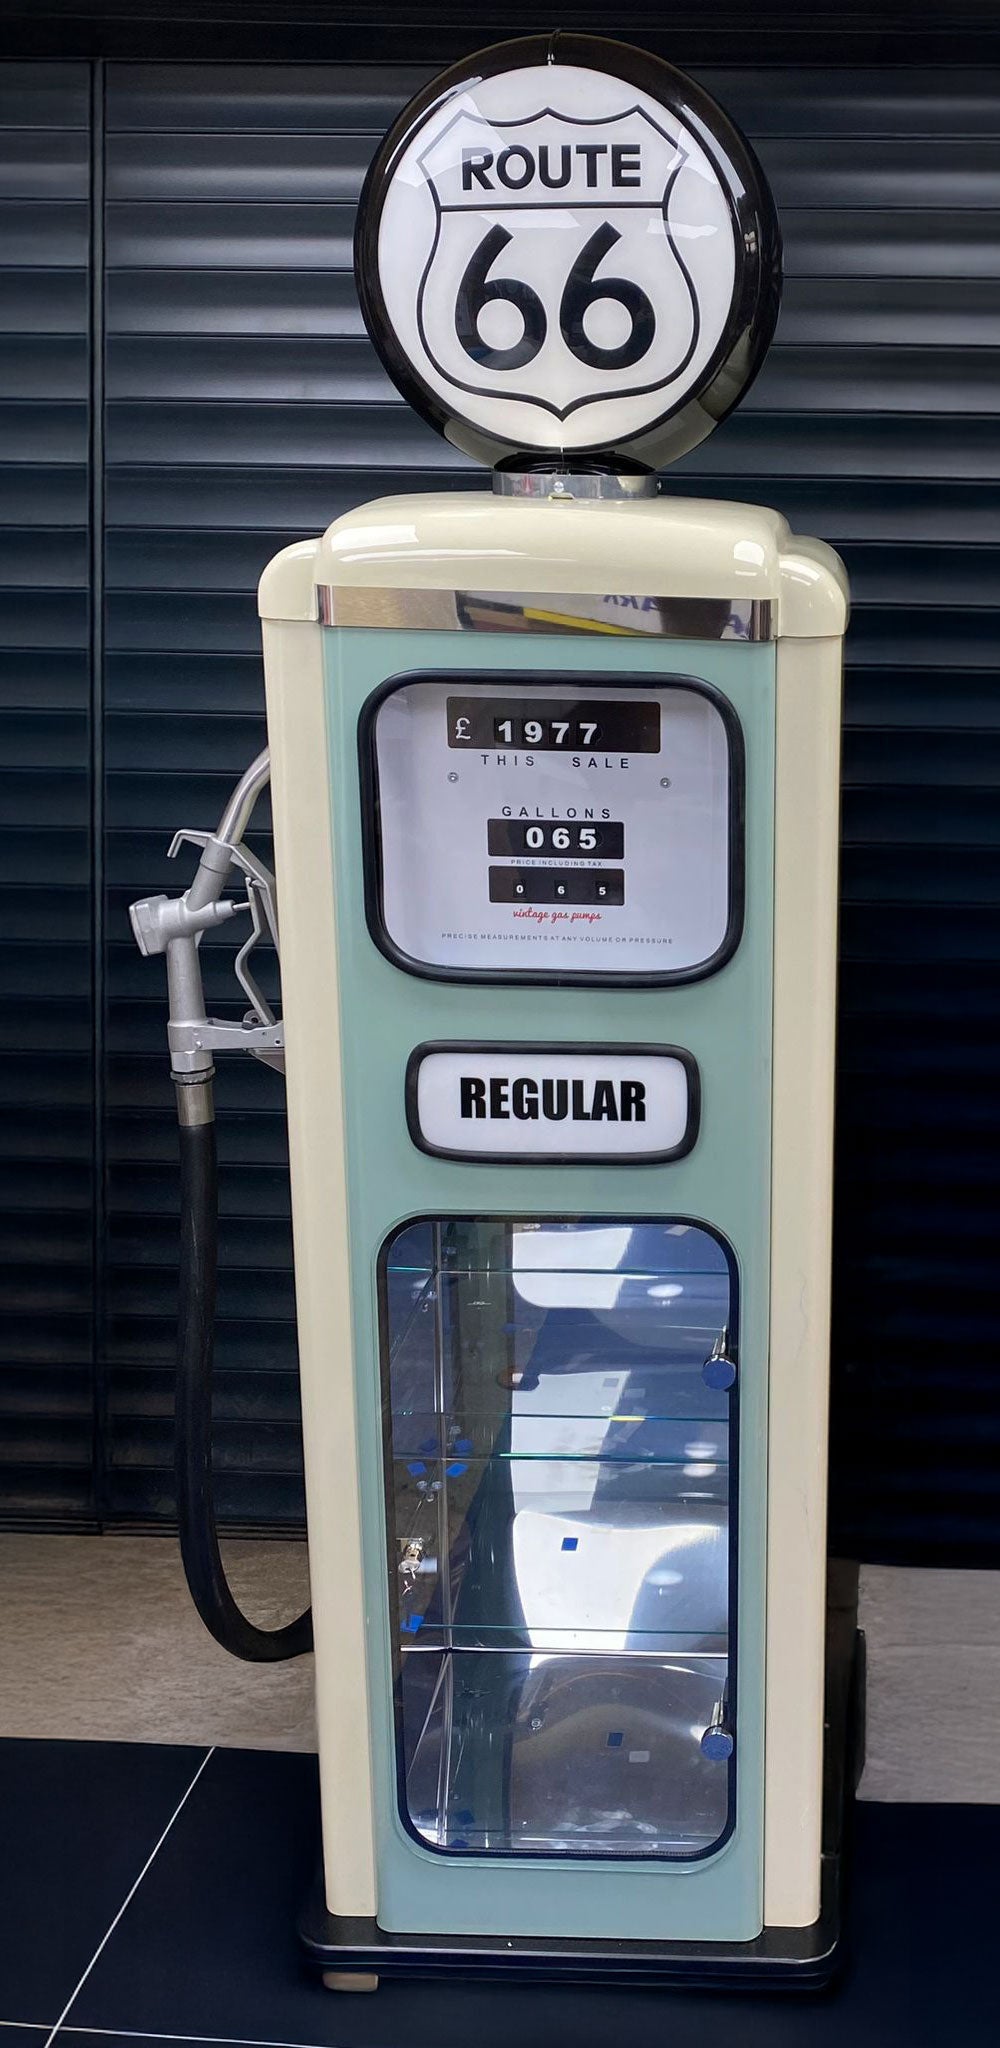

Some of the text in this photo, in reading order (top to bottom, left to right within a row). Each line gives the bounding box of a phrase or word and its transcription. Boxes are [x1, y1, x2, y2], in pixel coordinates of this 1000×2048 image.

[461, 143, 641, 191] ROUTE
[454, 220, 656, 372] 66
[455, 717, 598, 745] £ 1977
[480, 754, 630, 769] THIS SALE
[501, 806, 611, 819] GALLONS
[525, 826, 597, 850] 065
[538, 859, 585, 867] INCLUDING
[587, 860, 603, 868] TAX
[512, 906, 603, 924] vintage gas pumps
[441, 932, 478, 940] PRECISE
[480, 933, 548, 942] MEASUREMENTS
[561, 935, 578, 943] ANY
[628, 937, 673, 945] PRESSURE
[459, 1077, 647, 1122] REGULAR
